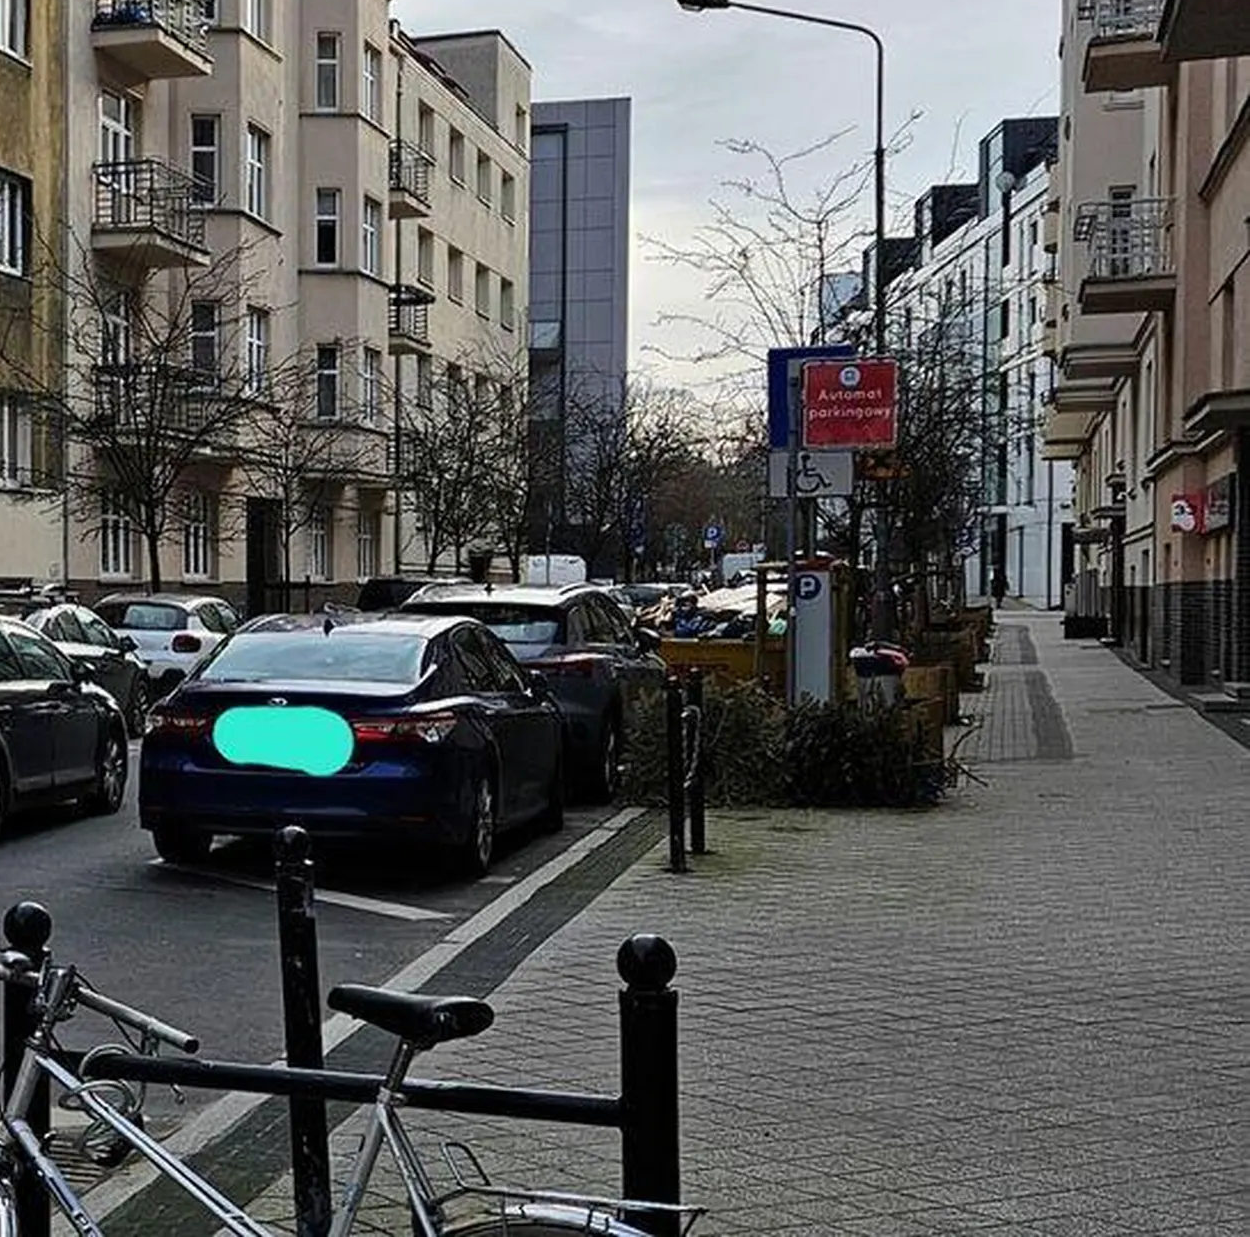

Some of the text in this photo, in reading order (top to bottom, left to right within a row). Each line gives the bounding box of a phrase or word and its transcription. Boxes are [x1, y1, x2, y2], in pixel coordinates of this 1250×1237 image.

[817, 389, 883, 401] Automat
[809, 405, 891, 421] parkingowy
[800, 577, 816, 597] P
